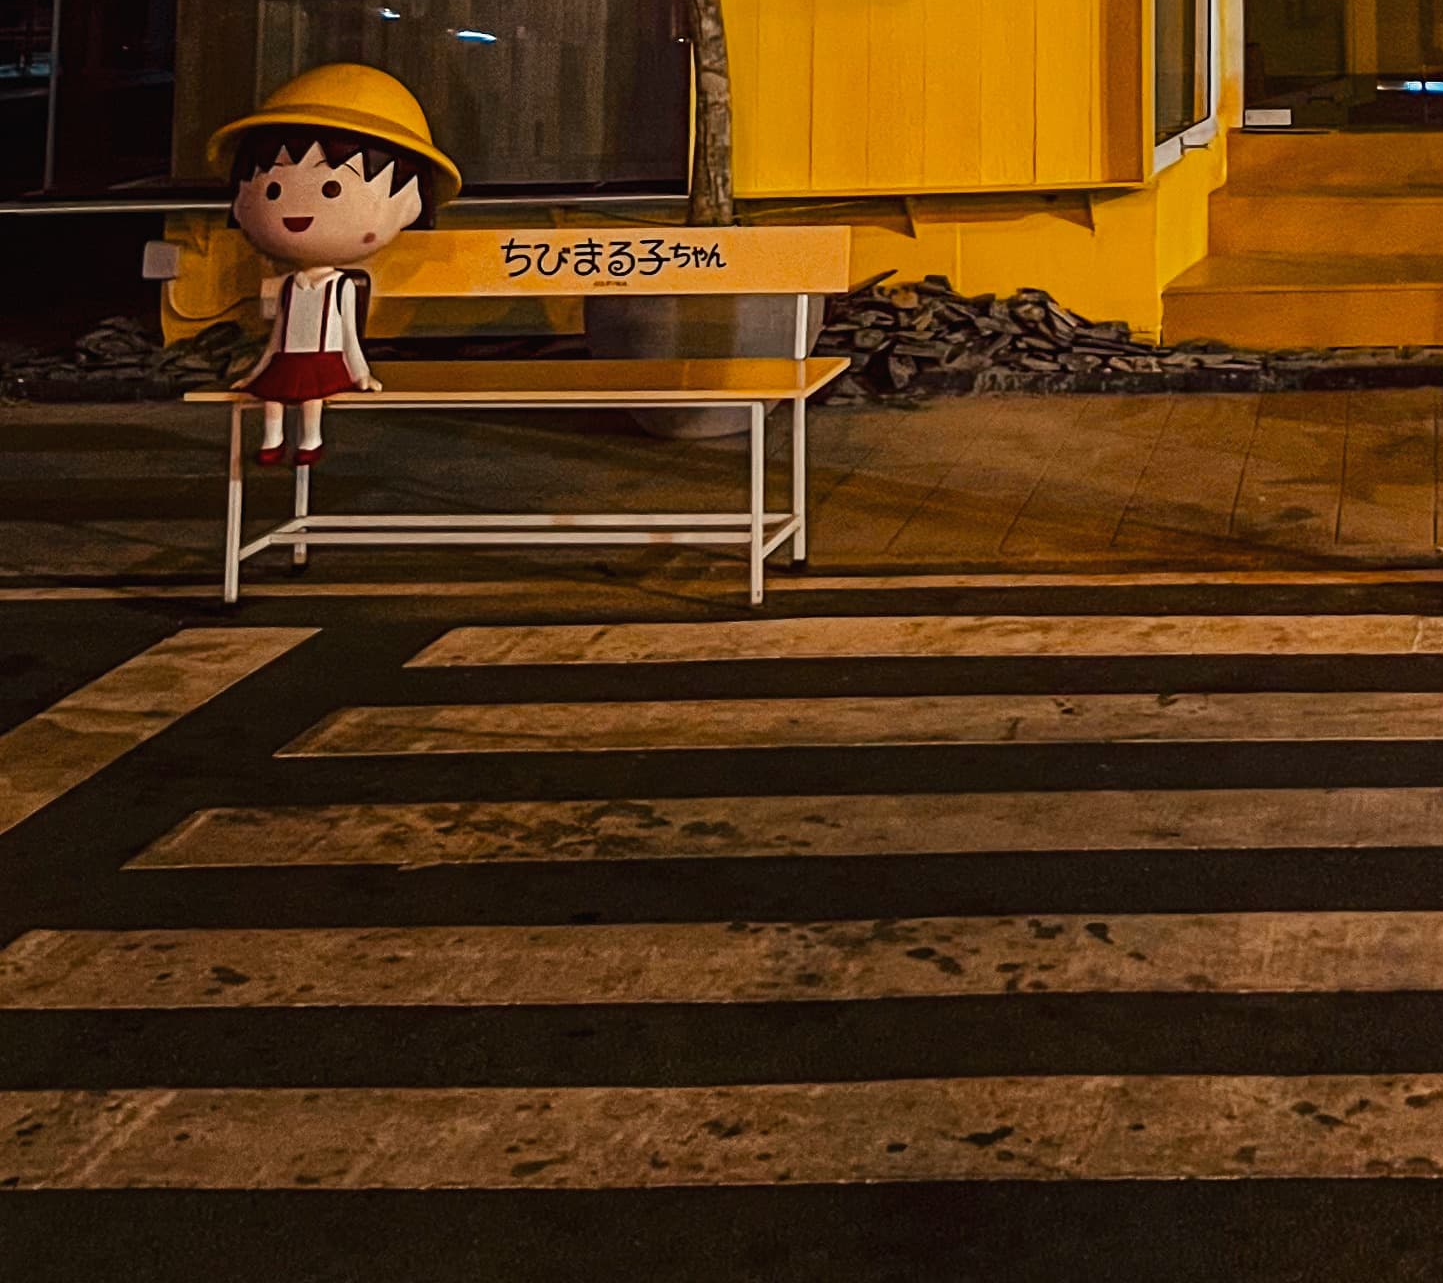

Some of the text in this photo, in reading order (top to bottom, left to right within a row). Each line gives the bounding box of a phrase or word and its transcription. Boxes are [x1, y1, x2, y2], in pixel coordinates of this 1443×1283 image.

[500, 238, 727, 277] ちびまる子ちゃん
